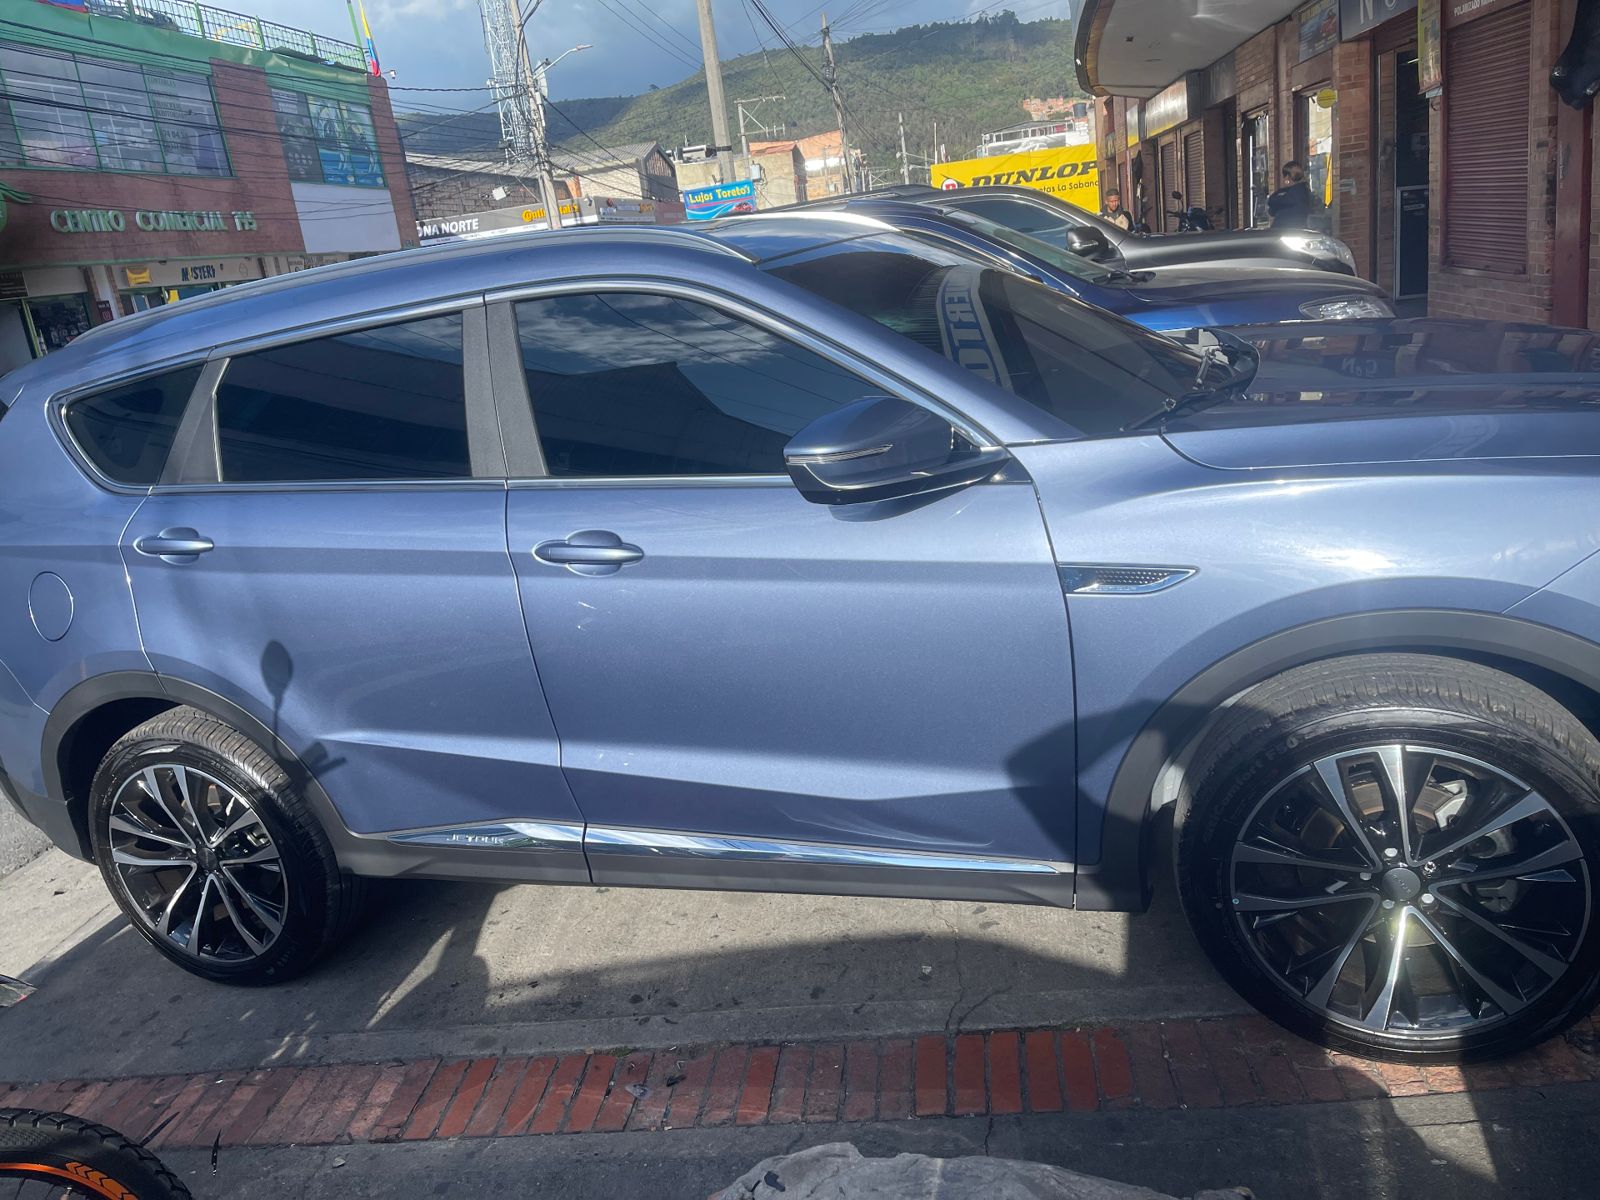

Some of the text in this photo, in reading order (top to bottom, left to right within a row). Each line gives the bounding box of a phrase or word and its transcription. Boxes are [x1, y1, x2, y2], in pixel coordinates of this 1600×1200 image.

[1057, 181, 1068, 191] La
[688, 191, 714, 204] Lujos
[50, 210, 126, 233] CENTRO
[135, 211, 228, 232] COMERCIAL
[445, 218, 479, 238] NORTE
